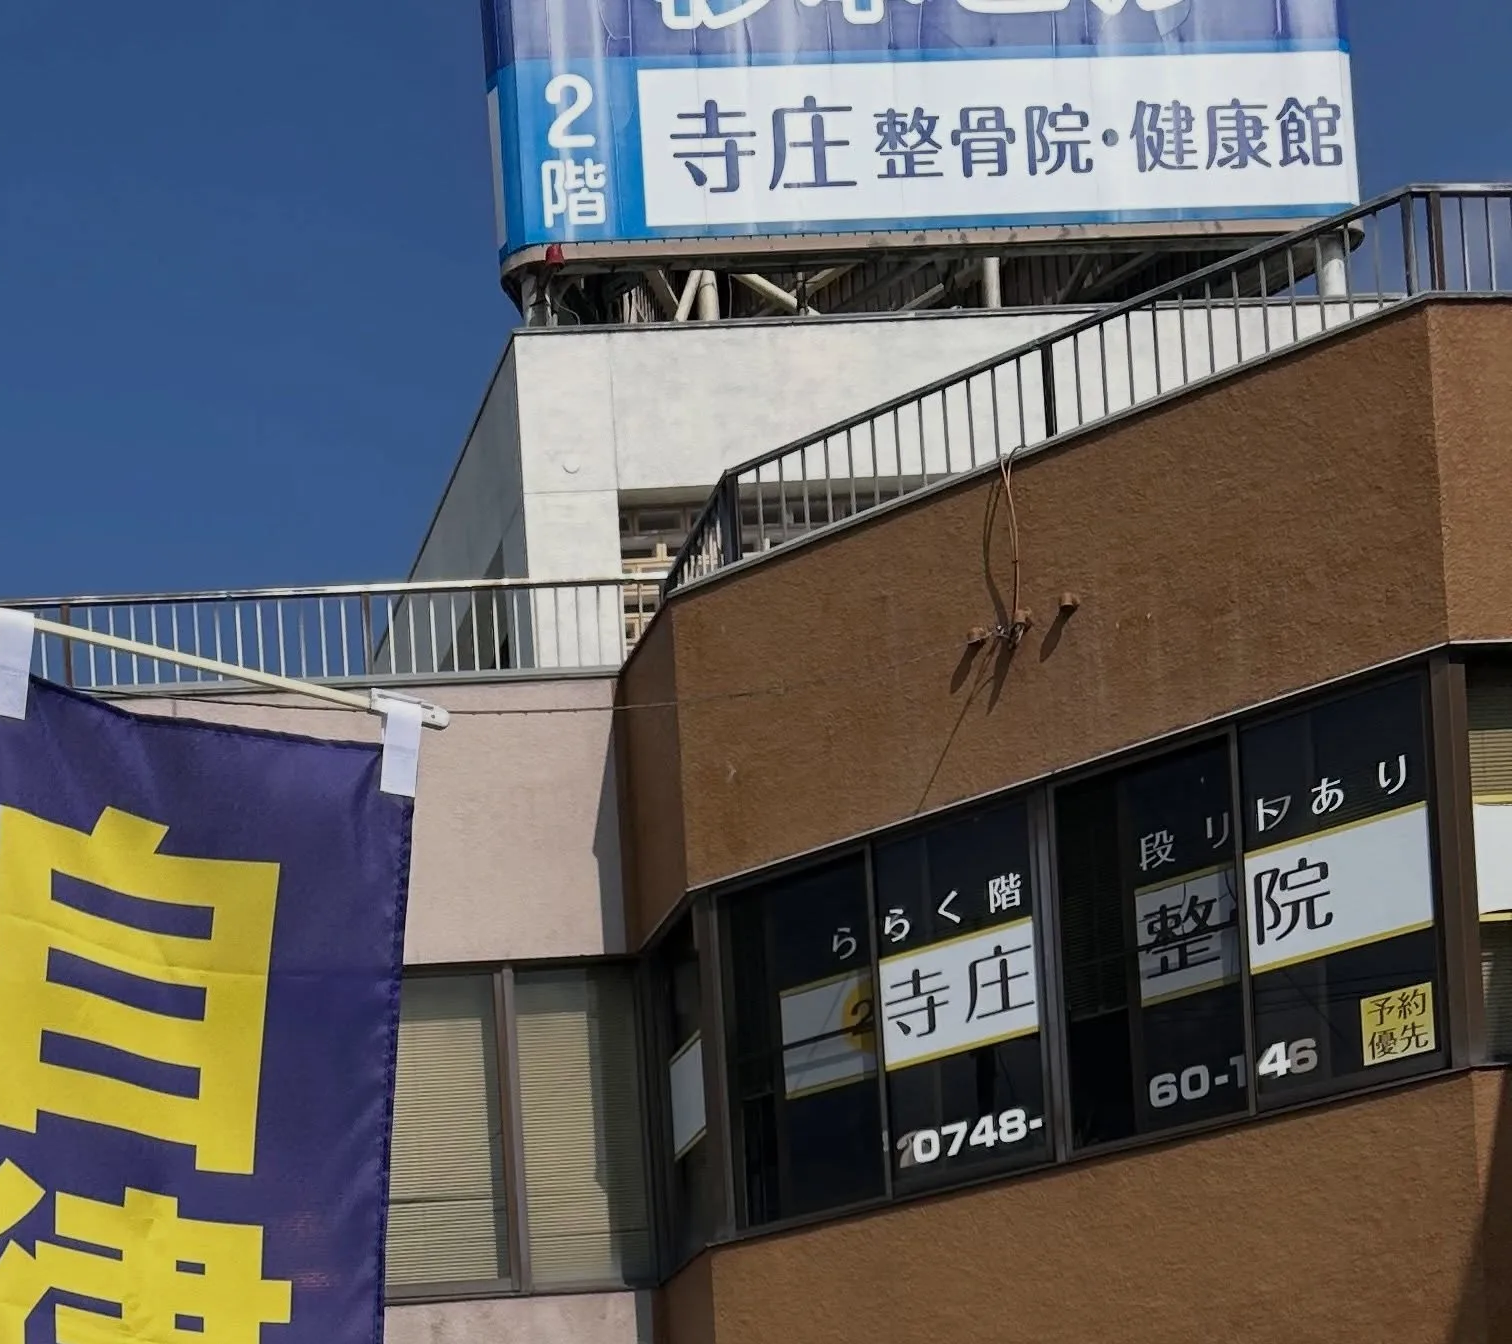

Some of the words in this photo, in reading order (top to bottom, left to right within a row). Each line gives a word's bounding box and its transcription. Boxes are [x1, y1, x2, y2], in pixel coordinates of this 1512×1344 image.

[885, 944, 1035, 1038] 寺庄
[1368, 989, 1427, 1027] 予約
[1368, 1022, 1429, 1061] 優先
[912, 1107, 1044, 1164] 0748-
